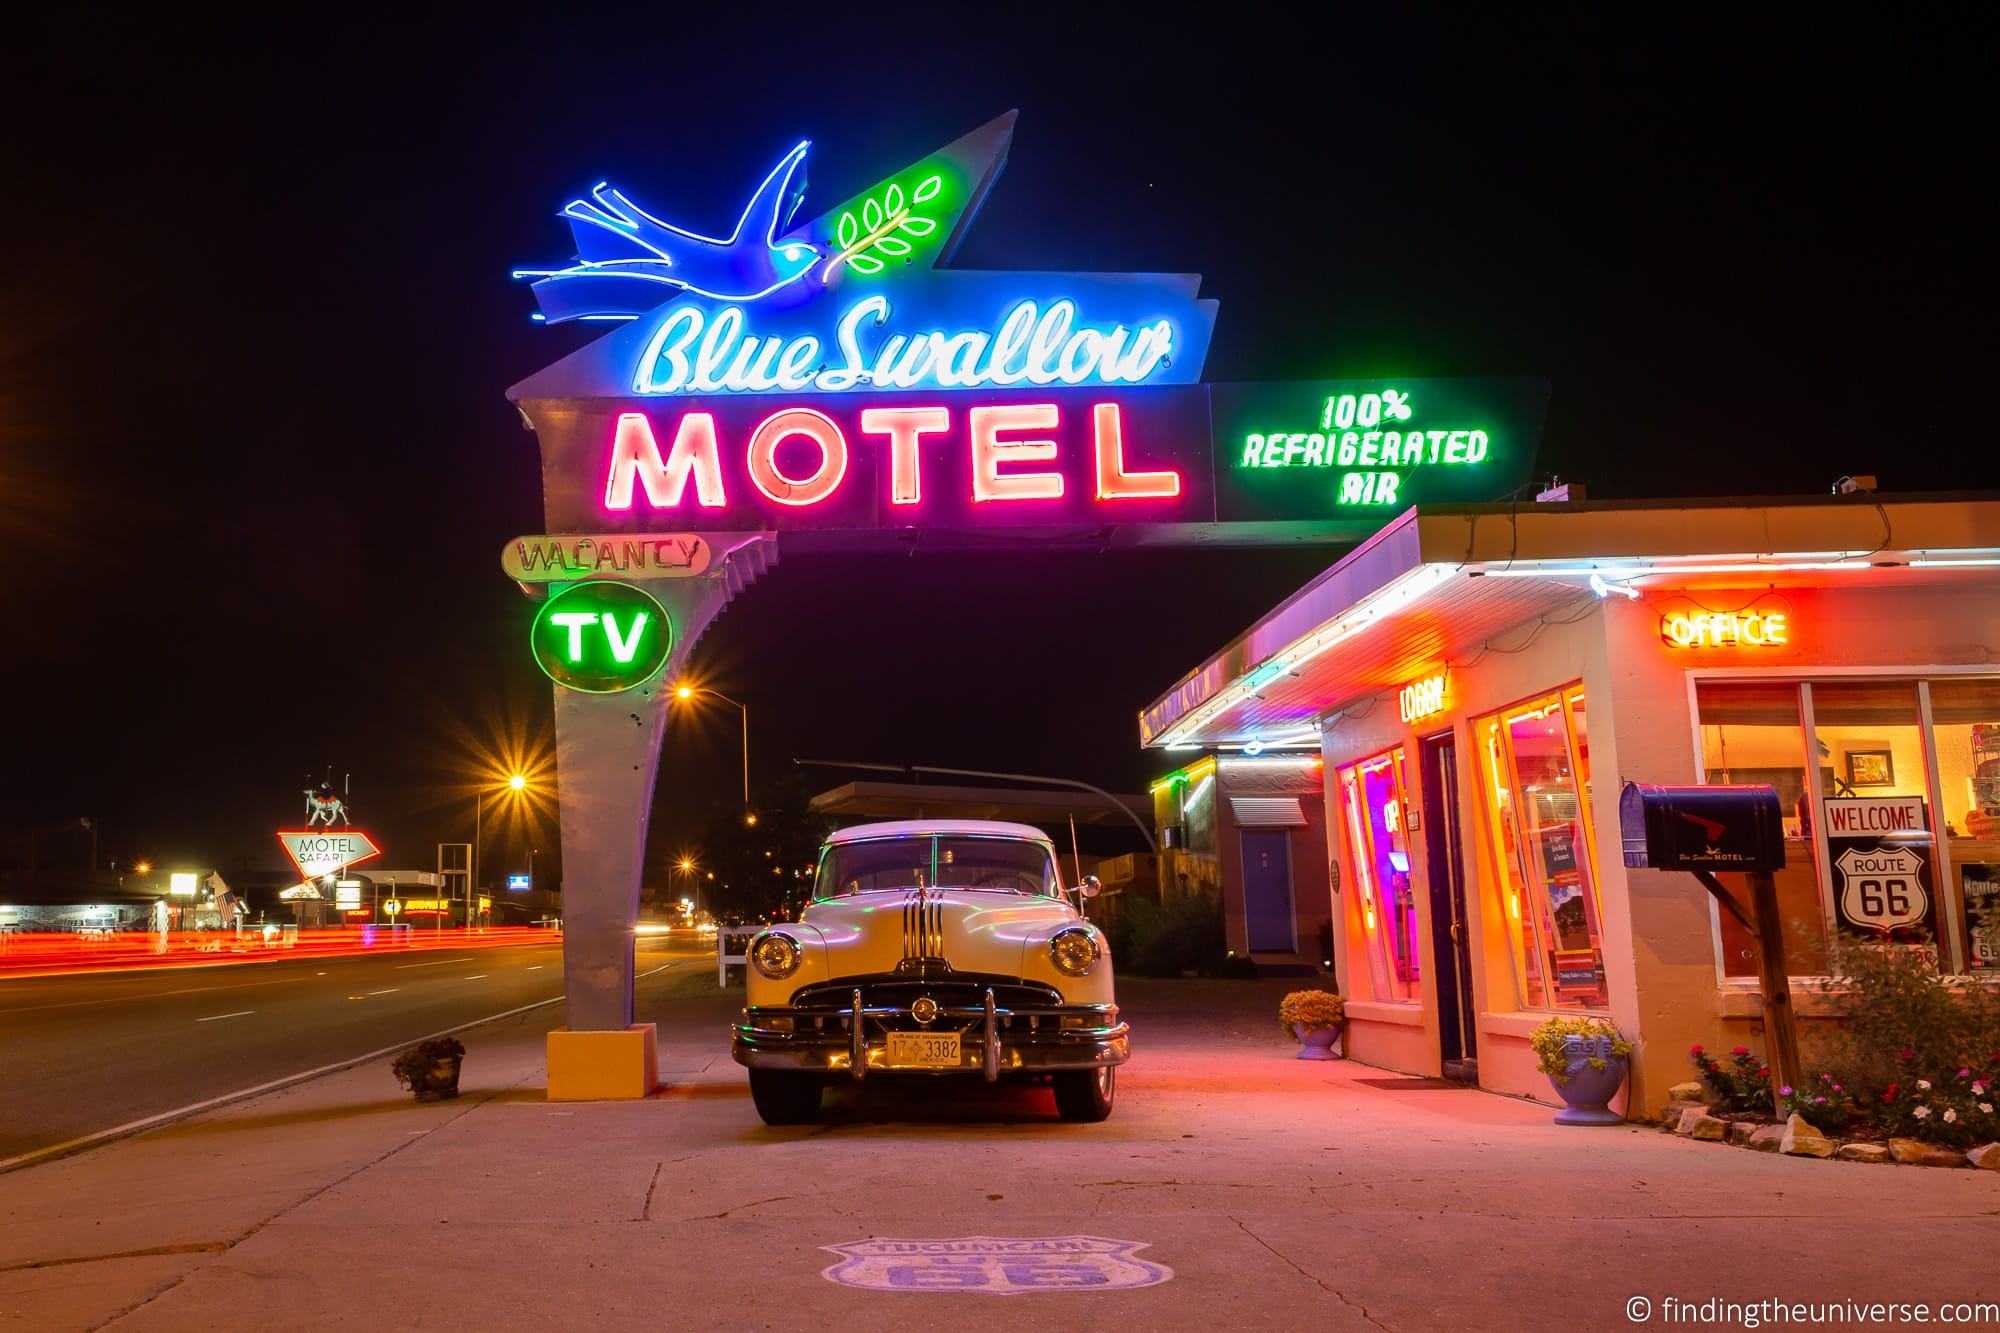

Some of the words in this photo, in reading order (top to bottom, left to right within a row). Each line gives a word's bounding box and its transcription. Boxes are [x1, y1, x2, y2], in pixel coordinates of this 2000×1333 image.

[630, 305, 820, 394] Blue
[814, 296, 1174, 388] Swallow
[1322, 389, 1412, 430] 100%
[605, 403, 1181, 509] MOTEL
[1241, 430, 1489, 467] REFRIGERATED
[1339, 472, 1400, 504] AIR
[517, 539, 700, 571] VACANCY
[550, 612, 650, 662] TV
[1670, 614, 1787, 645] OFFICE
[1400, 675, 1443, 723] LOBBY
[1830, 806, 1918, 831] WELCOME
[299, 838, 355, 852] MOTEL
[299, 854, 344, 863] SAFARI
[1854, 859, 1906, 872] ROUTE
[1860, 879, 1910, 916] 66
[893, 1040, 907, 1057] 17
[926, 1041, 958, 1058] 3382
[870, 1241, 1095, 1251] TUCUMCARI
[887, 1265, 1110, 1286] 66
